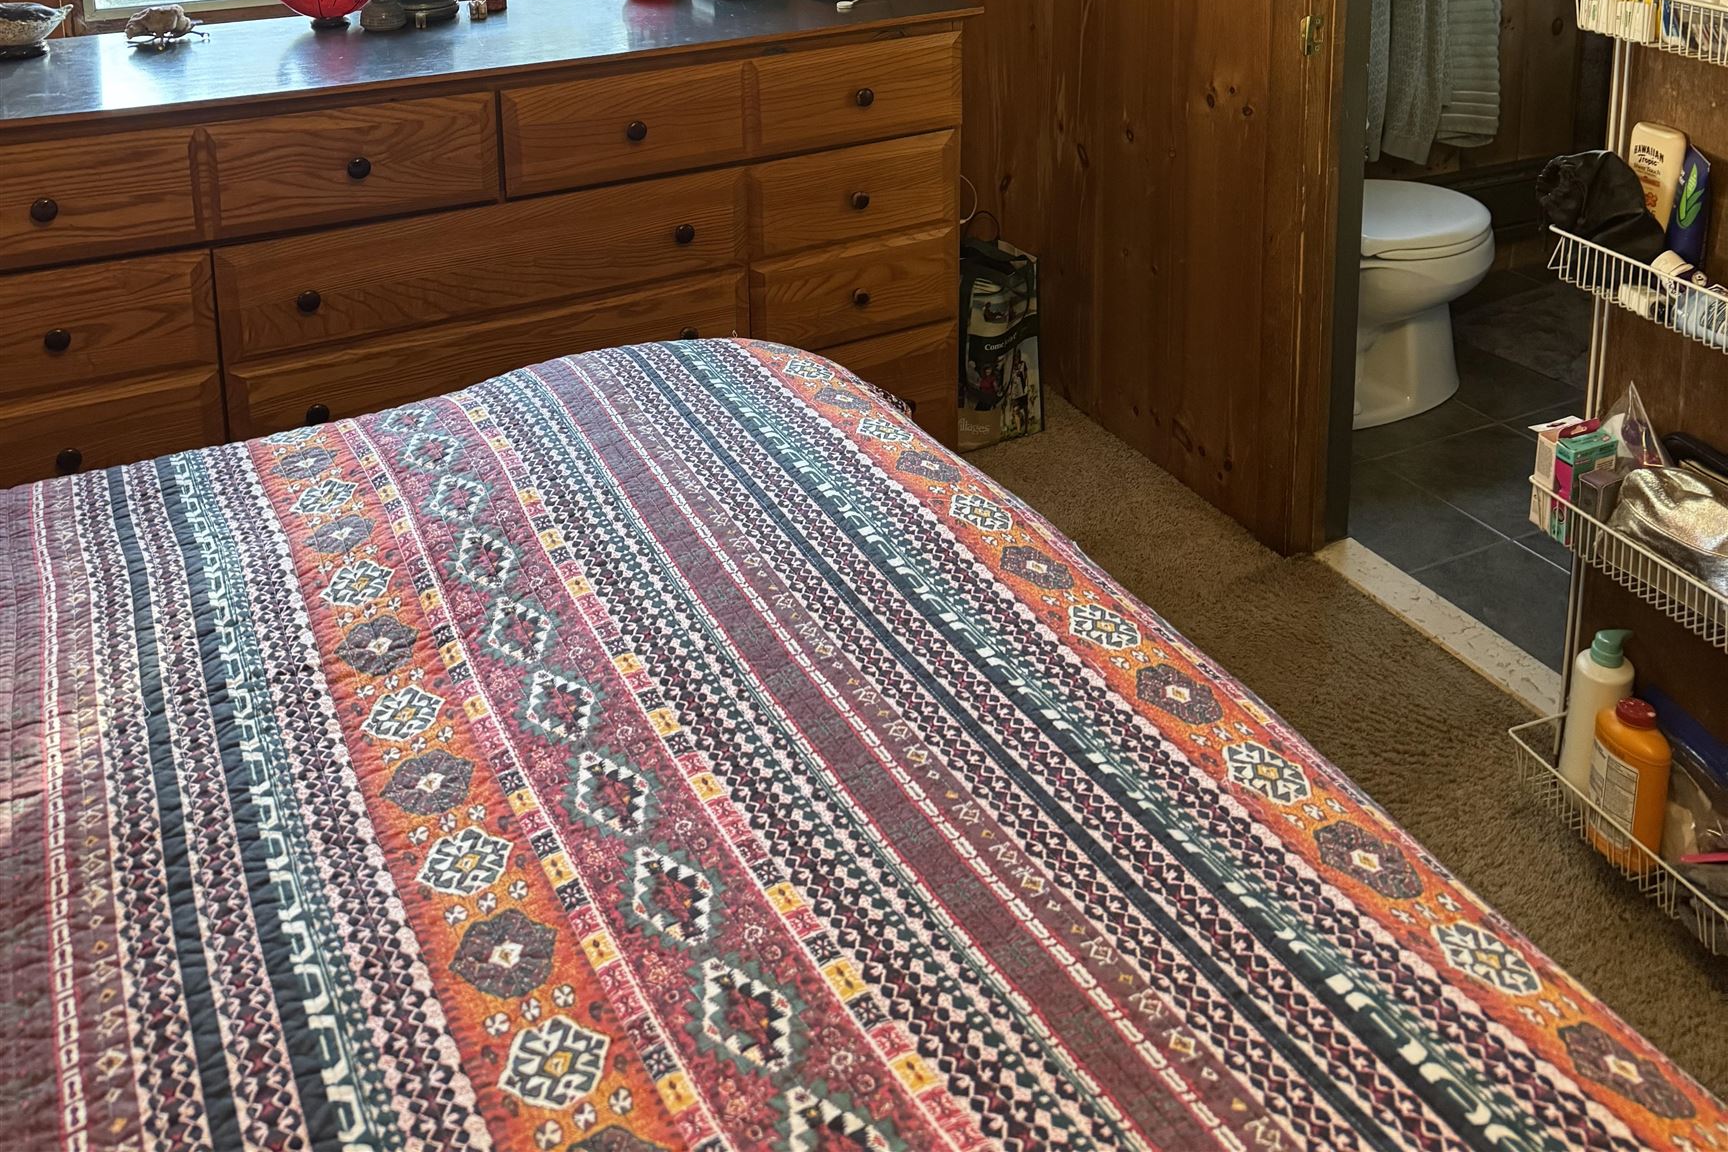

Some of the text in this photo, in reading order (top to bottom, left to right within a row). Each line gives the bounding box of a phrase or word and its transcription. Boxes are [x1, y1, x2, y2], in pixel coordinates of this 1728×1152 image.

[1634, 144, 1665, 163] HAWAIIAN
[1637, 153, 1659, 167] Tropic
[958, 418, 991, 434] illages
